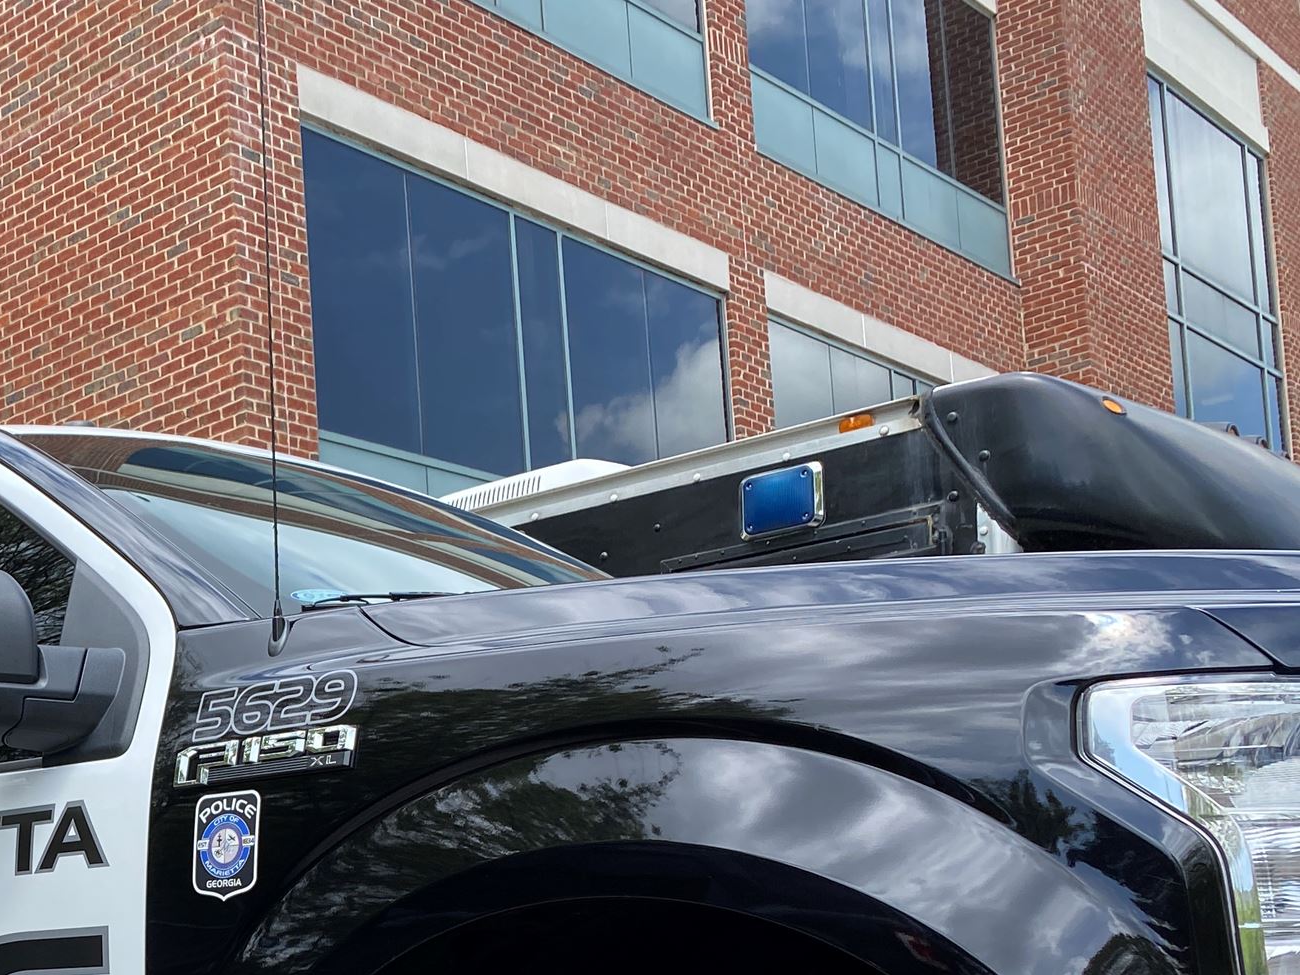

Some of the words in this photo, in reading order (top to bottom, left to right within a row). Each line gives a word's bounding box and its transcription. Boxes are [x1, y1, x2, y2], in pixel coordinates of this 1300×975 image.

[192, 669, 358, 742] 5629
[309, 754, 337, 767] XL
[199, 797, 257, 824] POLICE
[213, 815, 228, 826] CITY
[229, 815, 239, 823] OF
[205, 859, 245, 877] MARIETTA
[206, 878, 242, 888] GEORGIA
